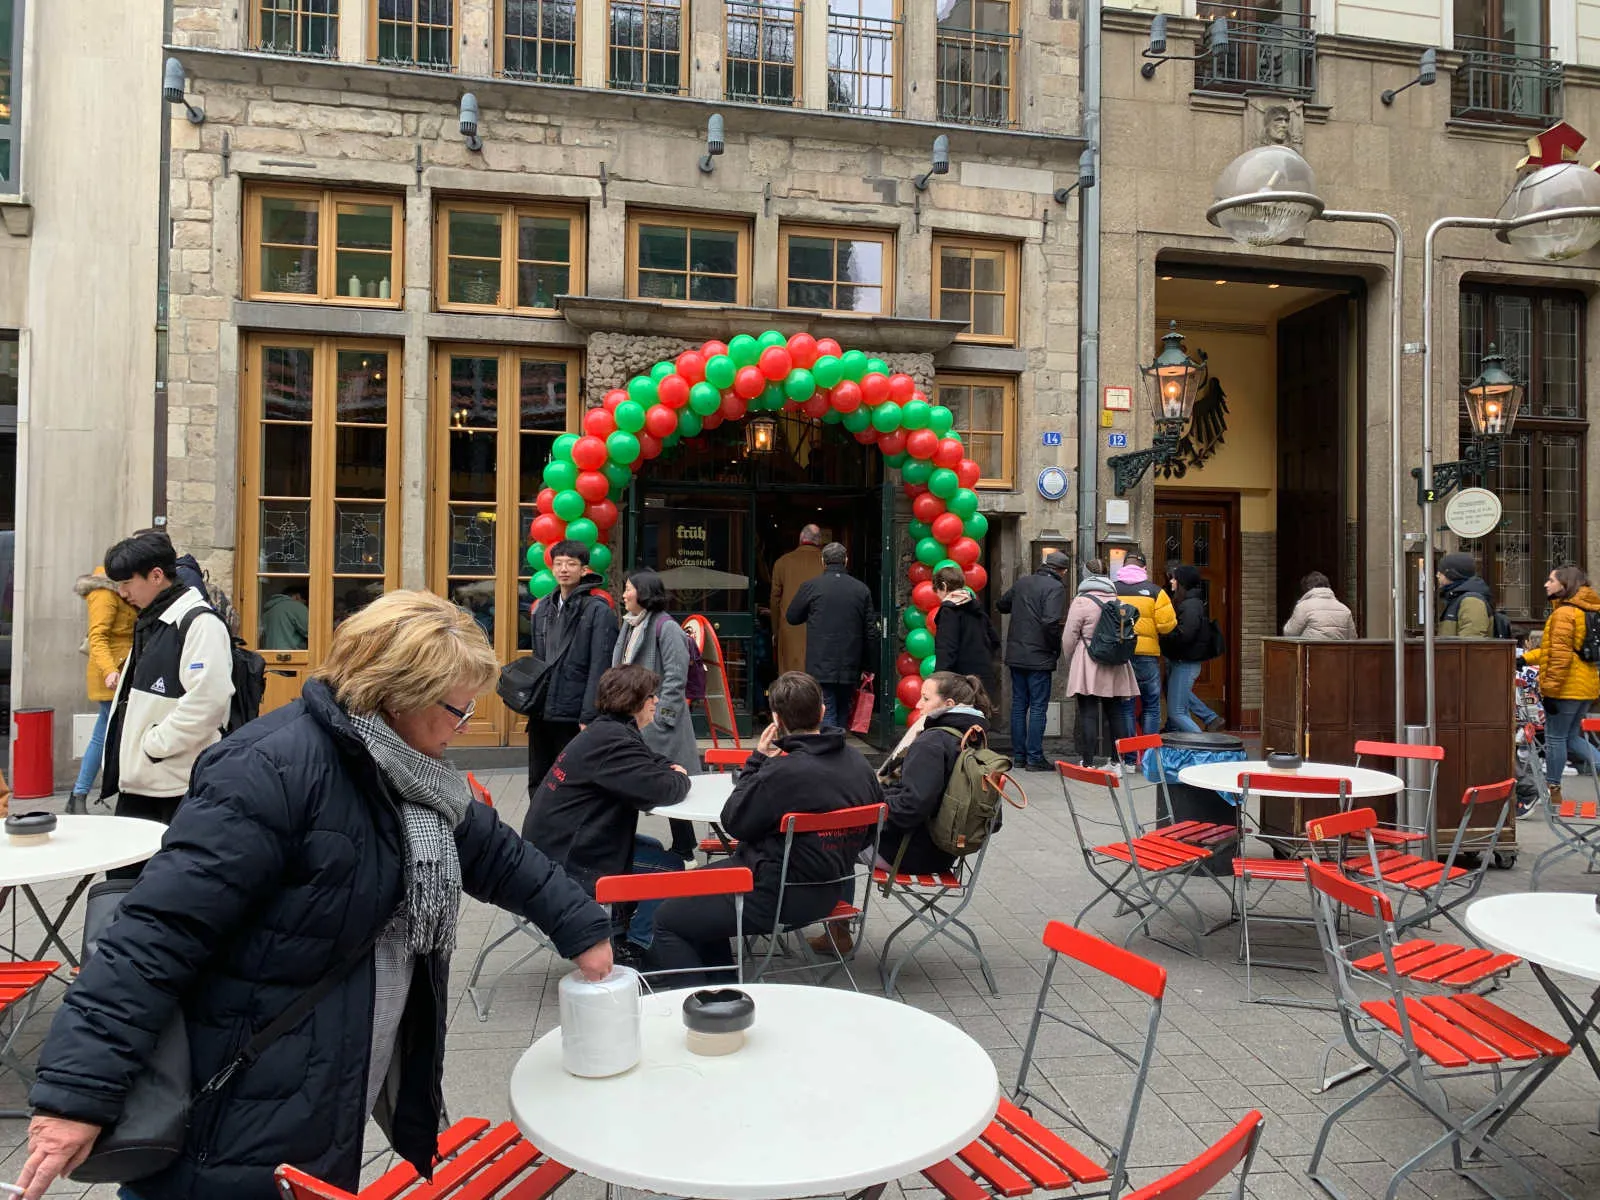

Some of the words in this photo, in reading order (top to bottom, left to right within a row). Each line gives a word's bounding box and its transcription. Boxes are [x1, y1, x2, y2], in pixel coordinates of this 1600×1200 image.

[1047, 433, 1059, 444] 14
[1112, 435, 1124, 446] 12
[1427, 491, 1435, 501] 2
[676, 525, 706, 541] früh
